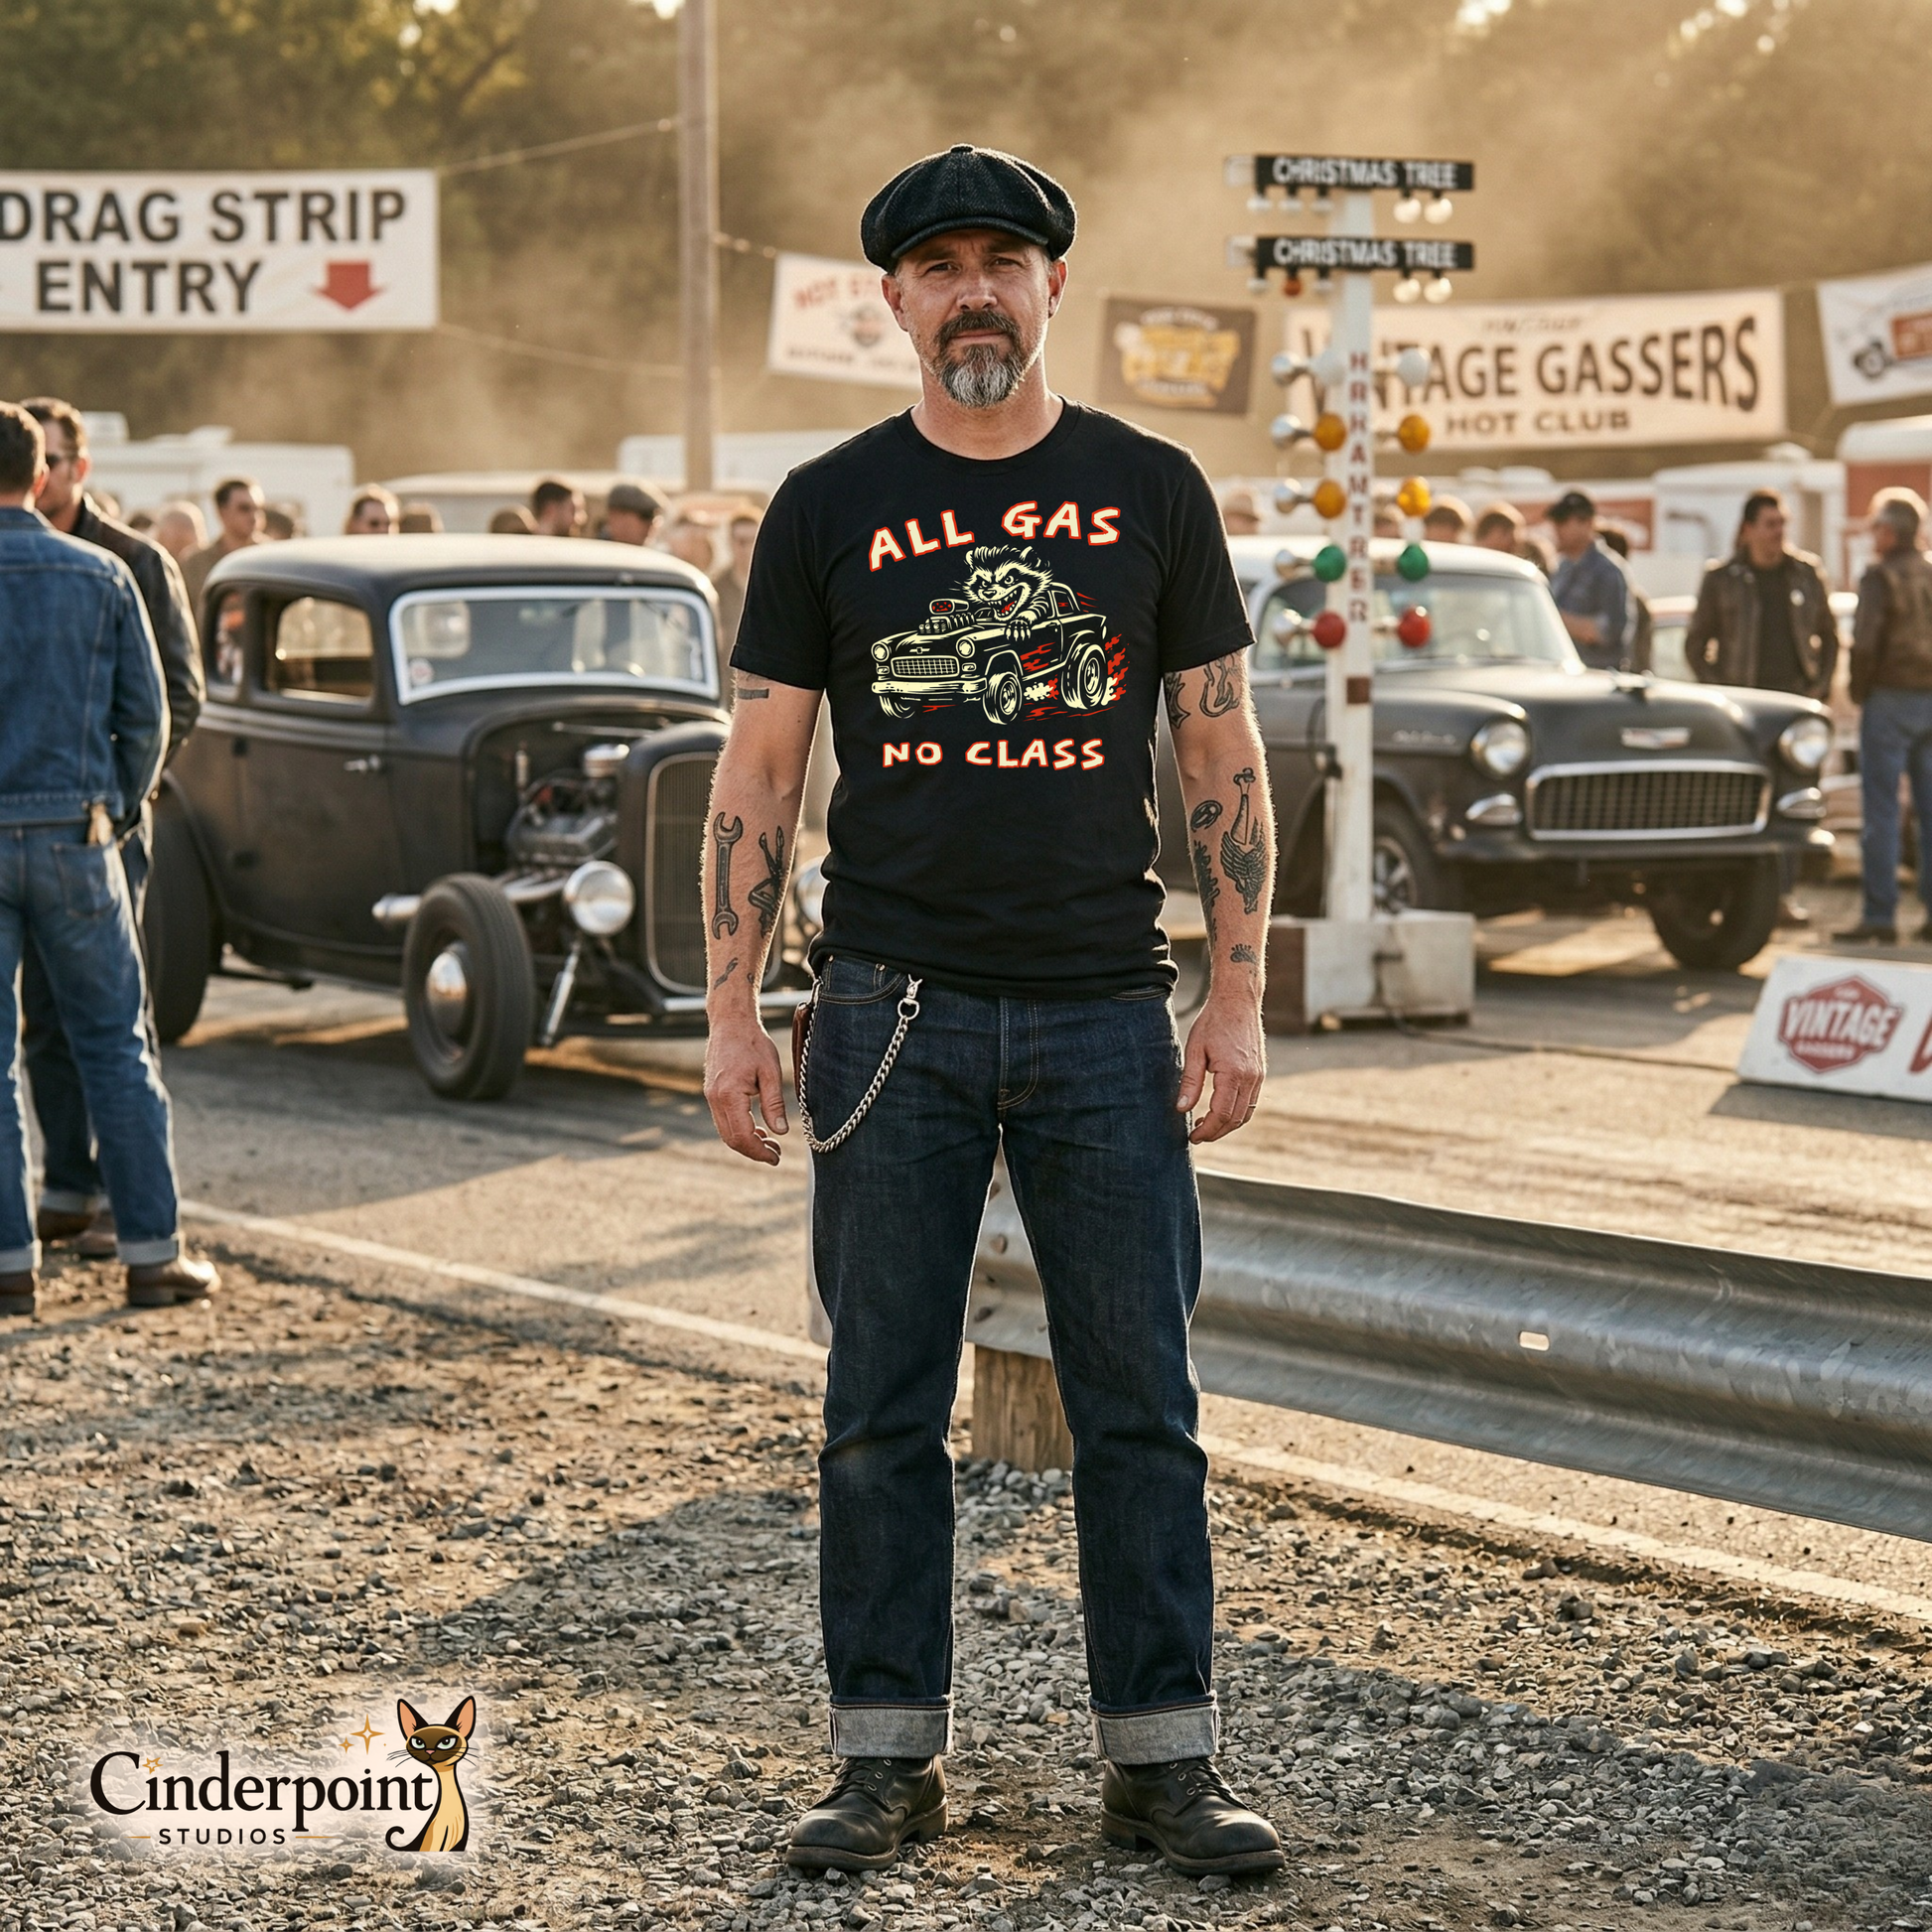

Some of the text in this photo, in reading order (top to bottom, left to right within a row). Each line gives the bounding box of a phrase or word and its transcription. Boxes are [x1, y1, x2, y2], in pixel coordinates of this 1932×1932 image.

[1273, 157, 1457, 189] CHRISTMAS TREE
[0, 190, 406, 243] DRAG STRIP
[1274, 237, 1456, 268] CHRISTMAS TREE
[37, 260, 262, 314] ENTRY
[1303, 314, 1758, 413] VTAGE GASSERS
[1447, 410, 1630, 434] HOT CLUB
[869, 500, 1121, 572] ALL GAS
[883, 738, 1105, 770] NO CLASS
[1784, 998, 1899, 1047] VINTAGE
